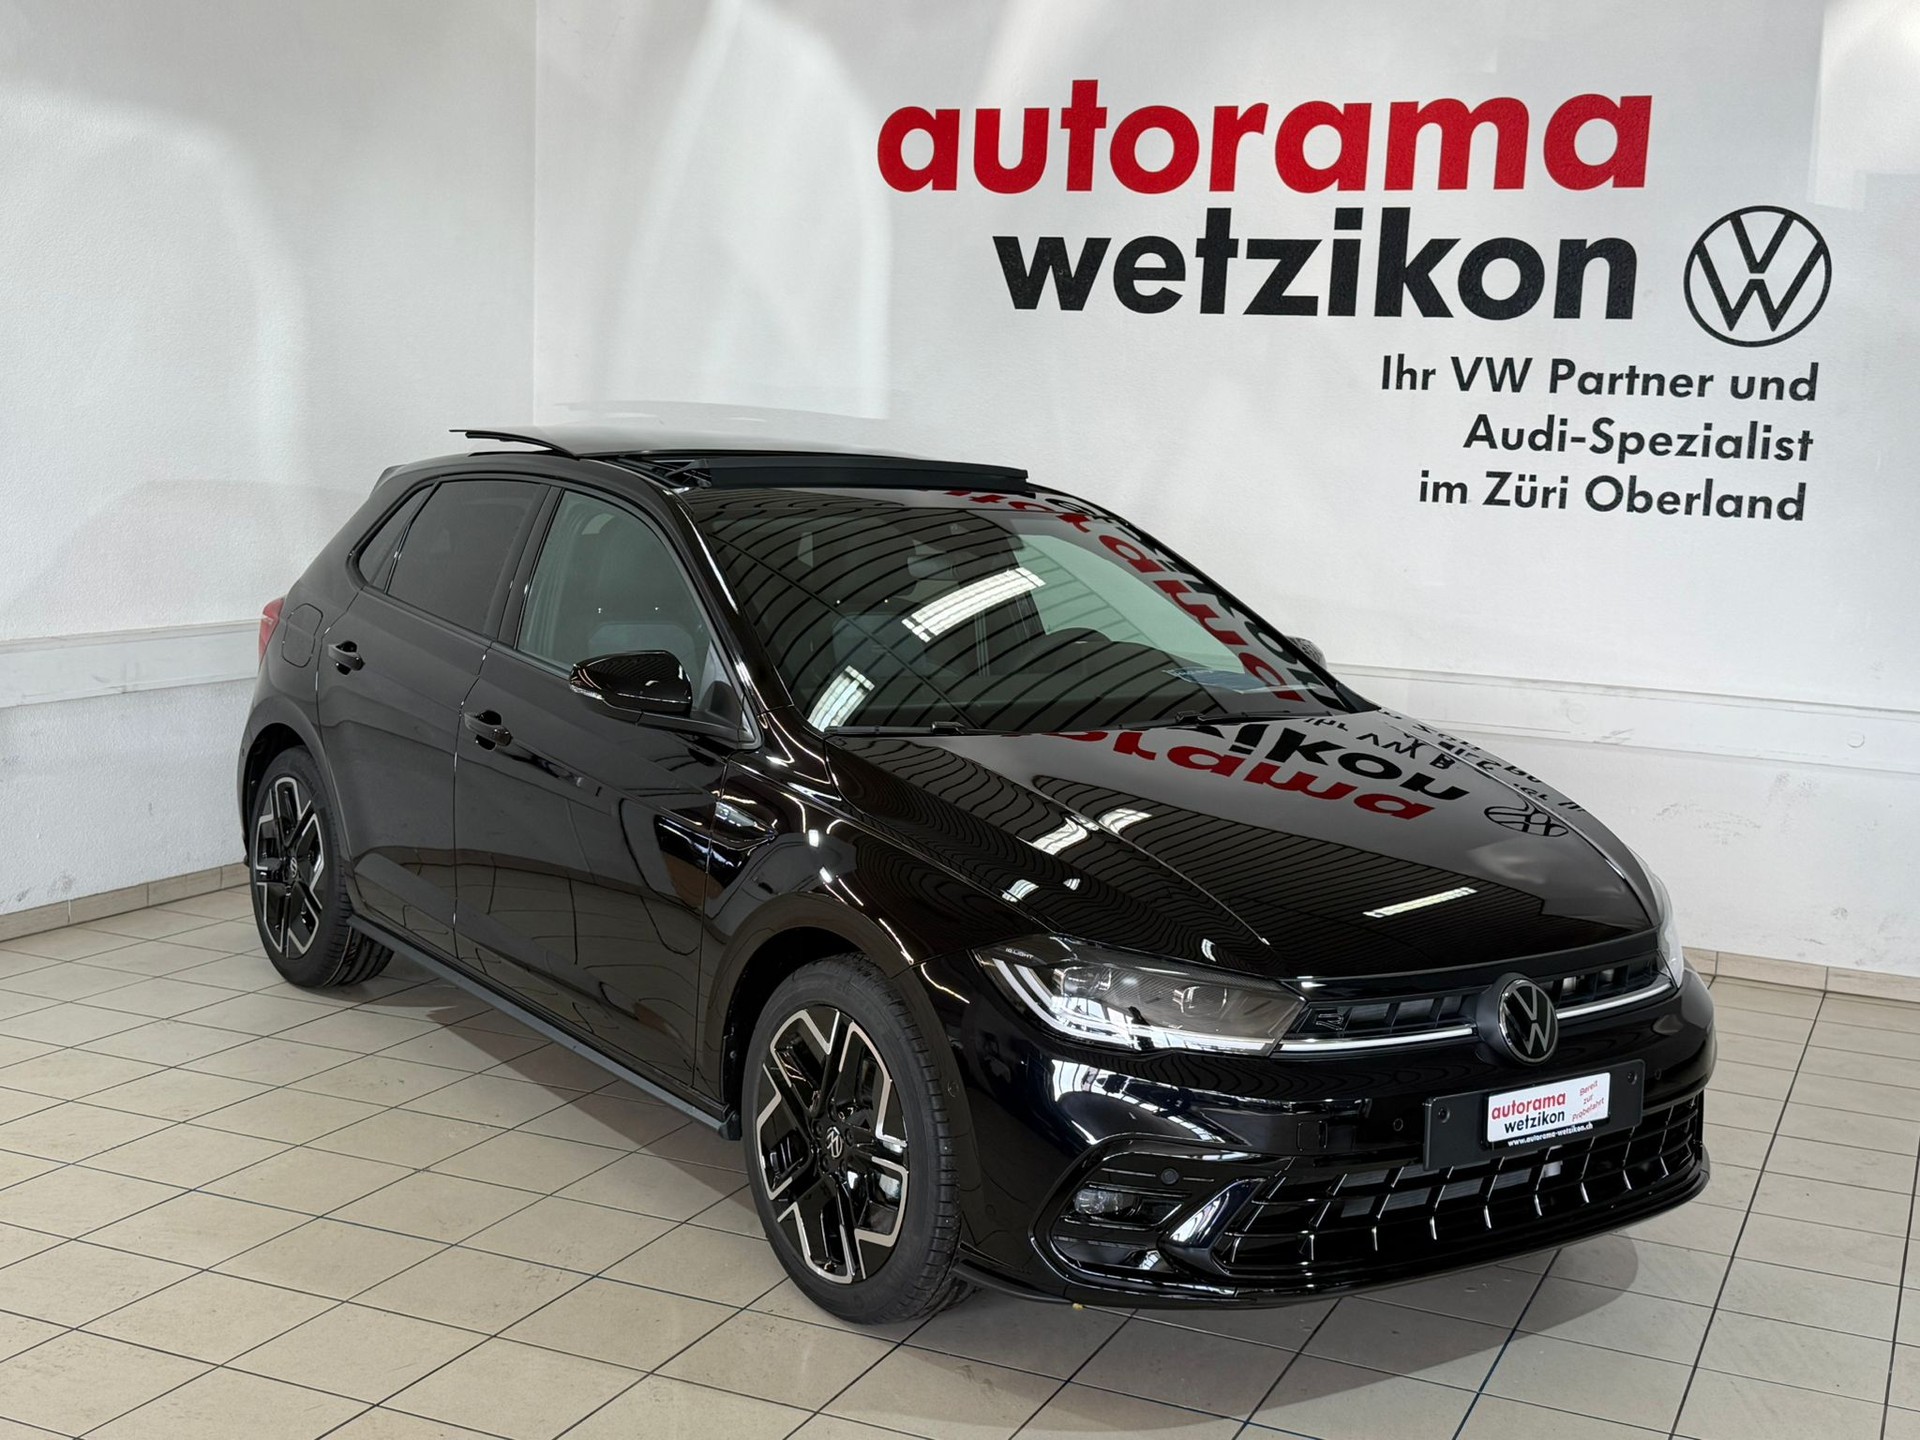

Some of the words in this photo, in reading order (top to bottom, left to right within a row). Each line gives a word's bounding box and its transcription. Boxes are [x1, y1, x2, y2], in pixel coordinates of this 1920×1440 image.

[878, 79, 1653, 195] autorama
[992, 207, 1638, 321] wetzikon
[1381, 353, 1436, 391] Ihr
[1450, 356, 1533, 393] VW
[1549, 358, 1714, 398] Partner
[1730, 361, 1819, 402] und
[1462, 412, 1814, 464] Audi-Spezialist
[1418, 470, 1468, 504] im
[1482, 471, 1569, 510] Züri
[1585, 475, 1807, 521] Oberland
[1579, 1080, 1599, 1096] Bereit
[1583, 1093, 1594, 1105] zur
[1491, 1092, 1567, 1120] autorama
[1571, 1096, 1605, 1122] Probefahrt
[1504, 1110, 1566, 1134] wetzikon
[1507, 1122, 1593, 1147] www.autorama-wetzikon.ch
